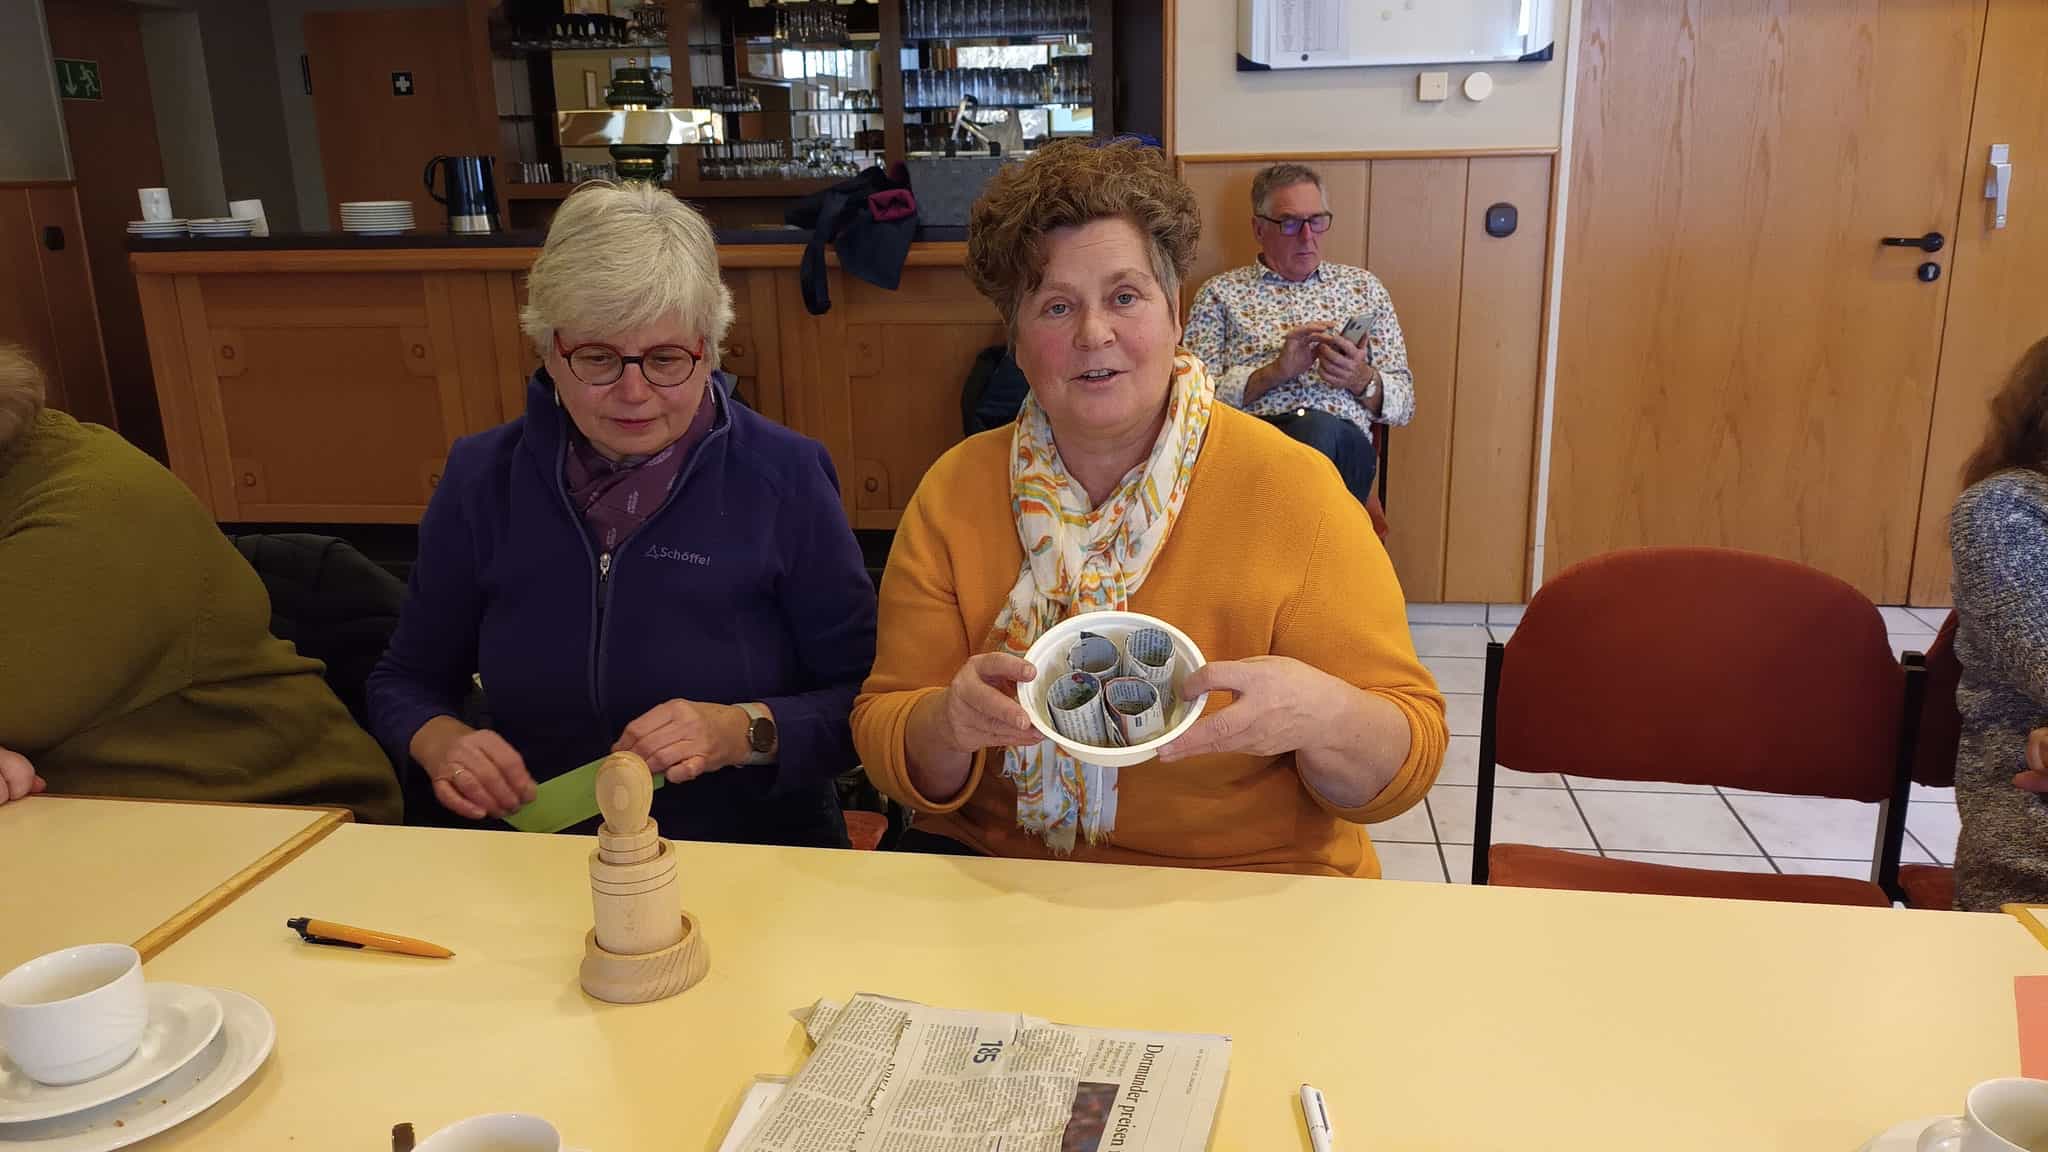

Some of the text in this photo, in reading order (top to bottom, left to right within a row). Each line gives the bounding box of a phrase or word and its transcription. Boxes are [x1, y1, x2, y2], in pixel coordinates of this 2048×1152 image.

[973, 1040, 1003, 1063] 185
[1126, 1044, 1164, 1103] Dortmunder
[1110, 1104, 1137, 1147] preisen
